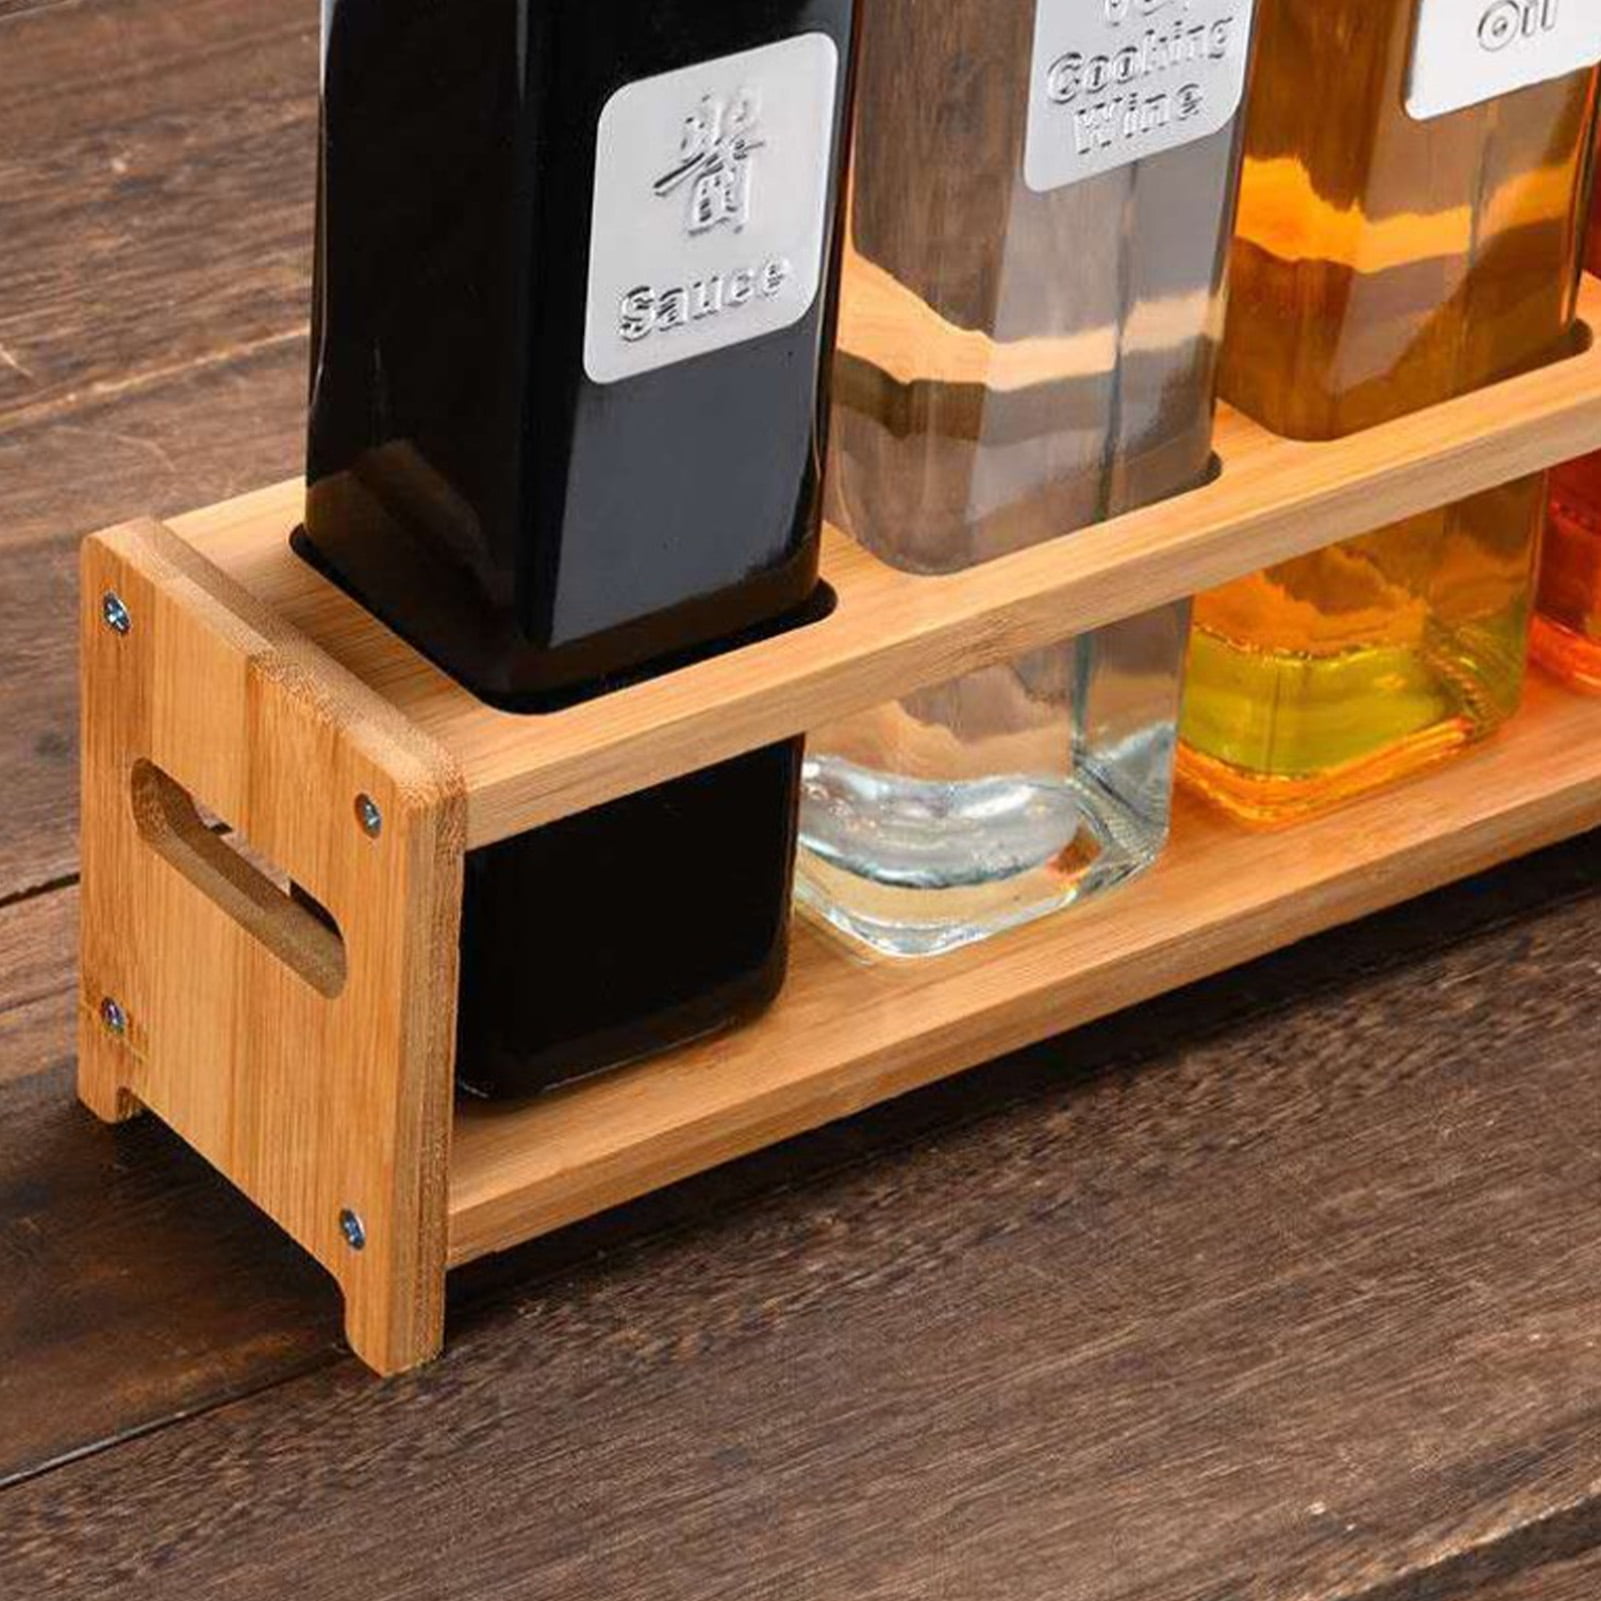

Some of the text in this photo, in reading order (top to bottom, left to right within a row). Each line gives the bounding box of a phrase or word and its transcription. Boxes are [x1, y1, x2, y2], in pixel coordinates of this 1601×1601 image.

[1047, 17, 1234, 105] Cooking
[1073, 82, 1203, 156] Wine
[618, 256, 793, 343] Sauce
